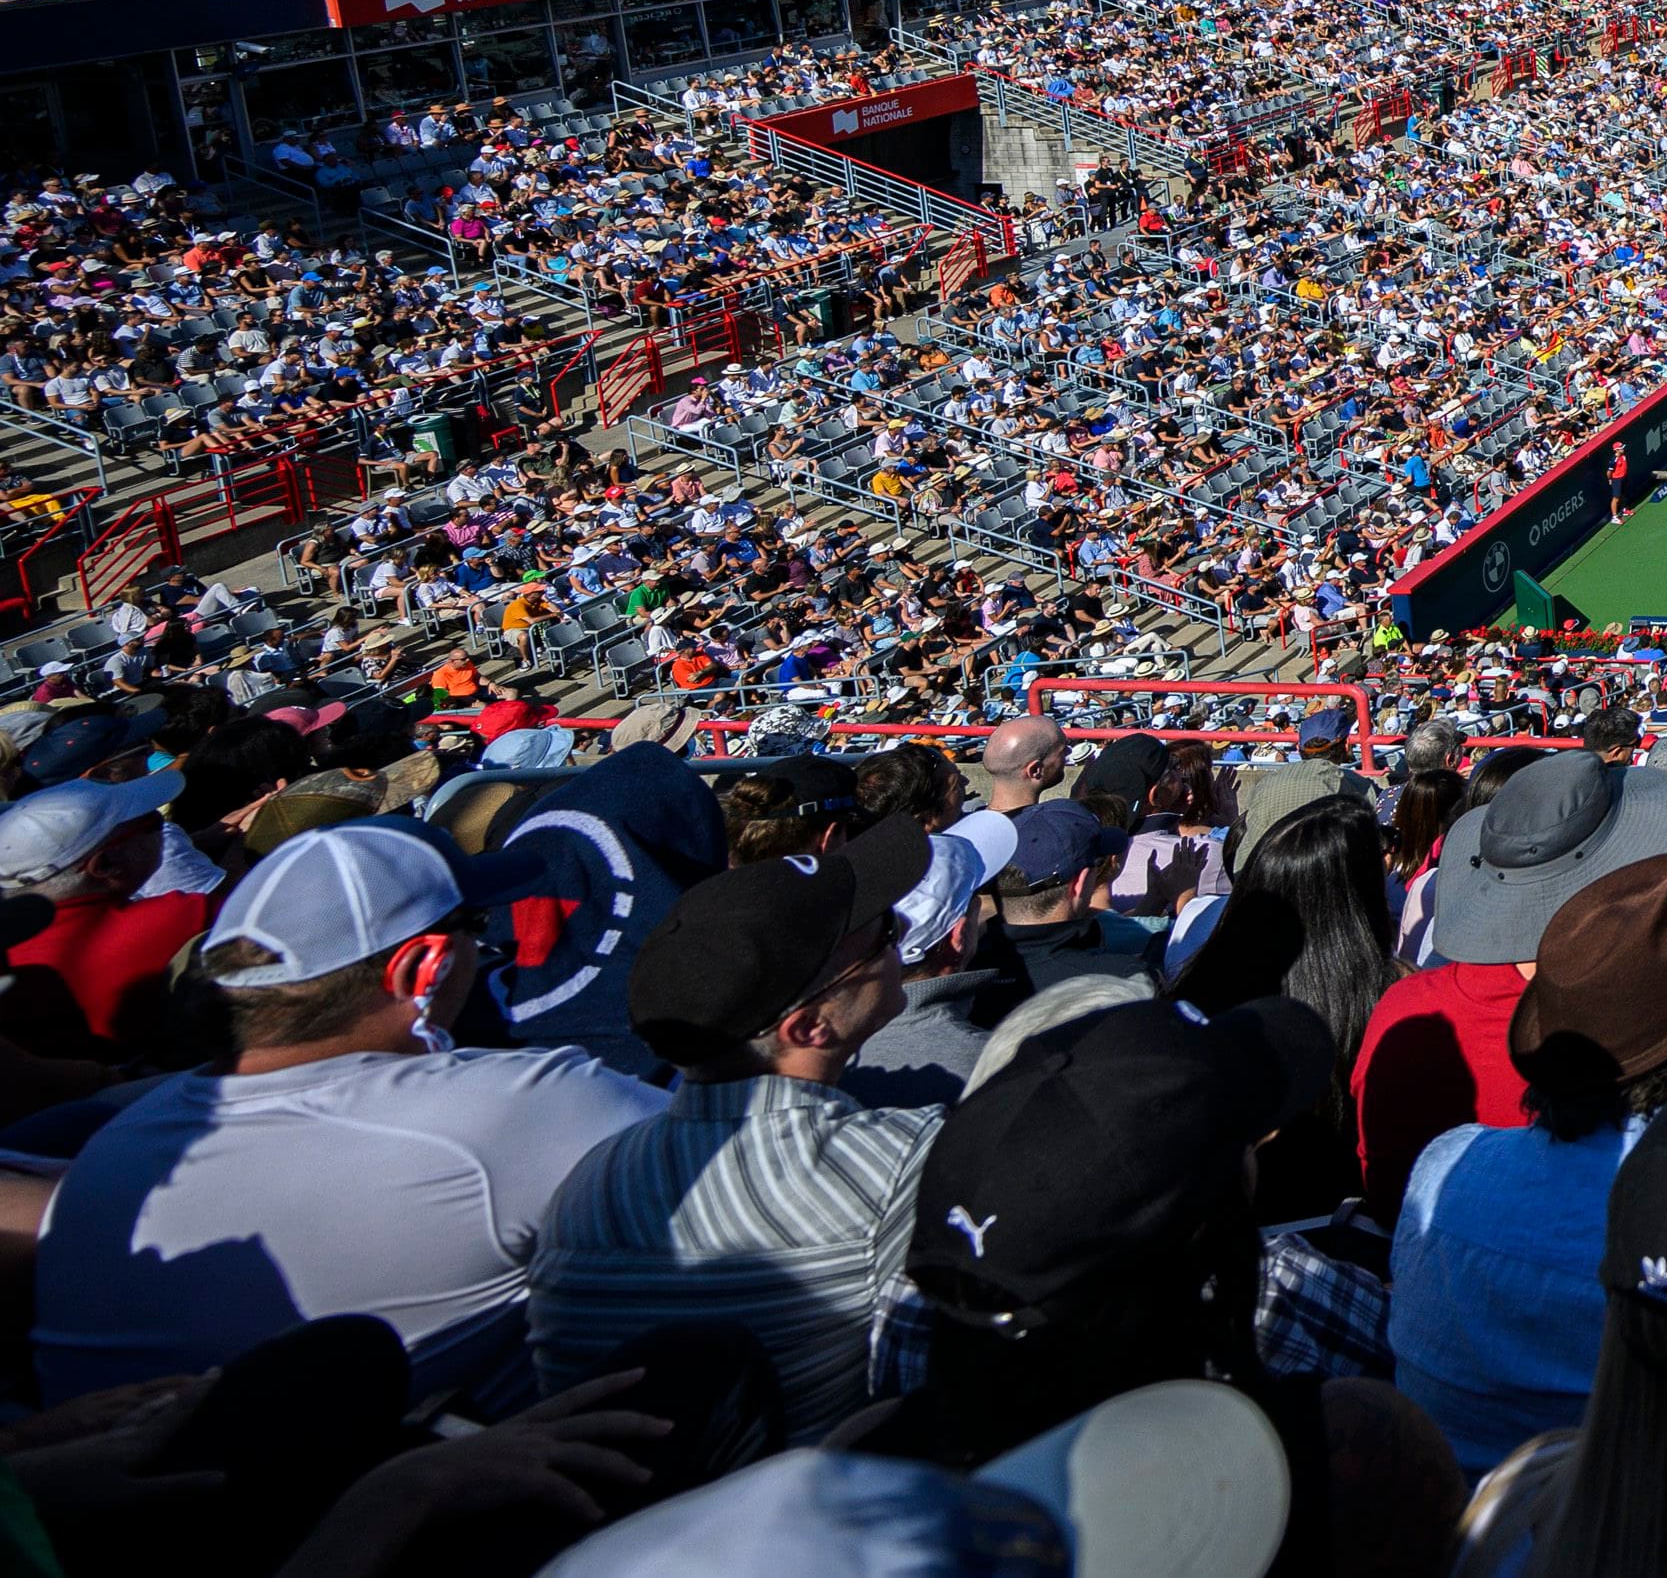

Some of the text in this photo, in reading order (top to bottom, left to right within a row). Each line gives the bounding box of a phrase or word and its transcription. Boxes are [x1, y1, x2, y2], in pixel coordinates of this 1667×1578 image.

[861, 98, 900, 116] BANQUE
[862, 106, 915, 128] NATIONALE
[1542, 490, 1584, 536] ROGERS
